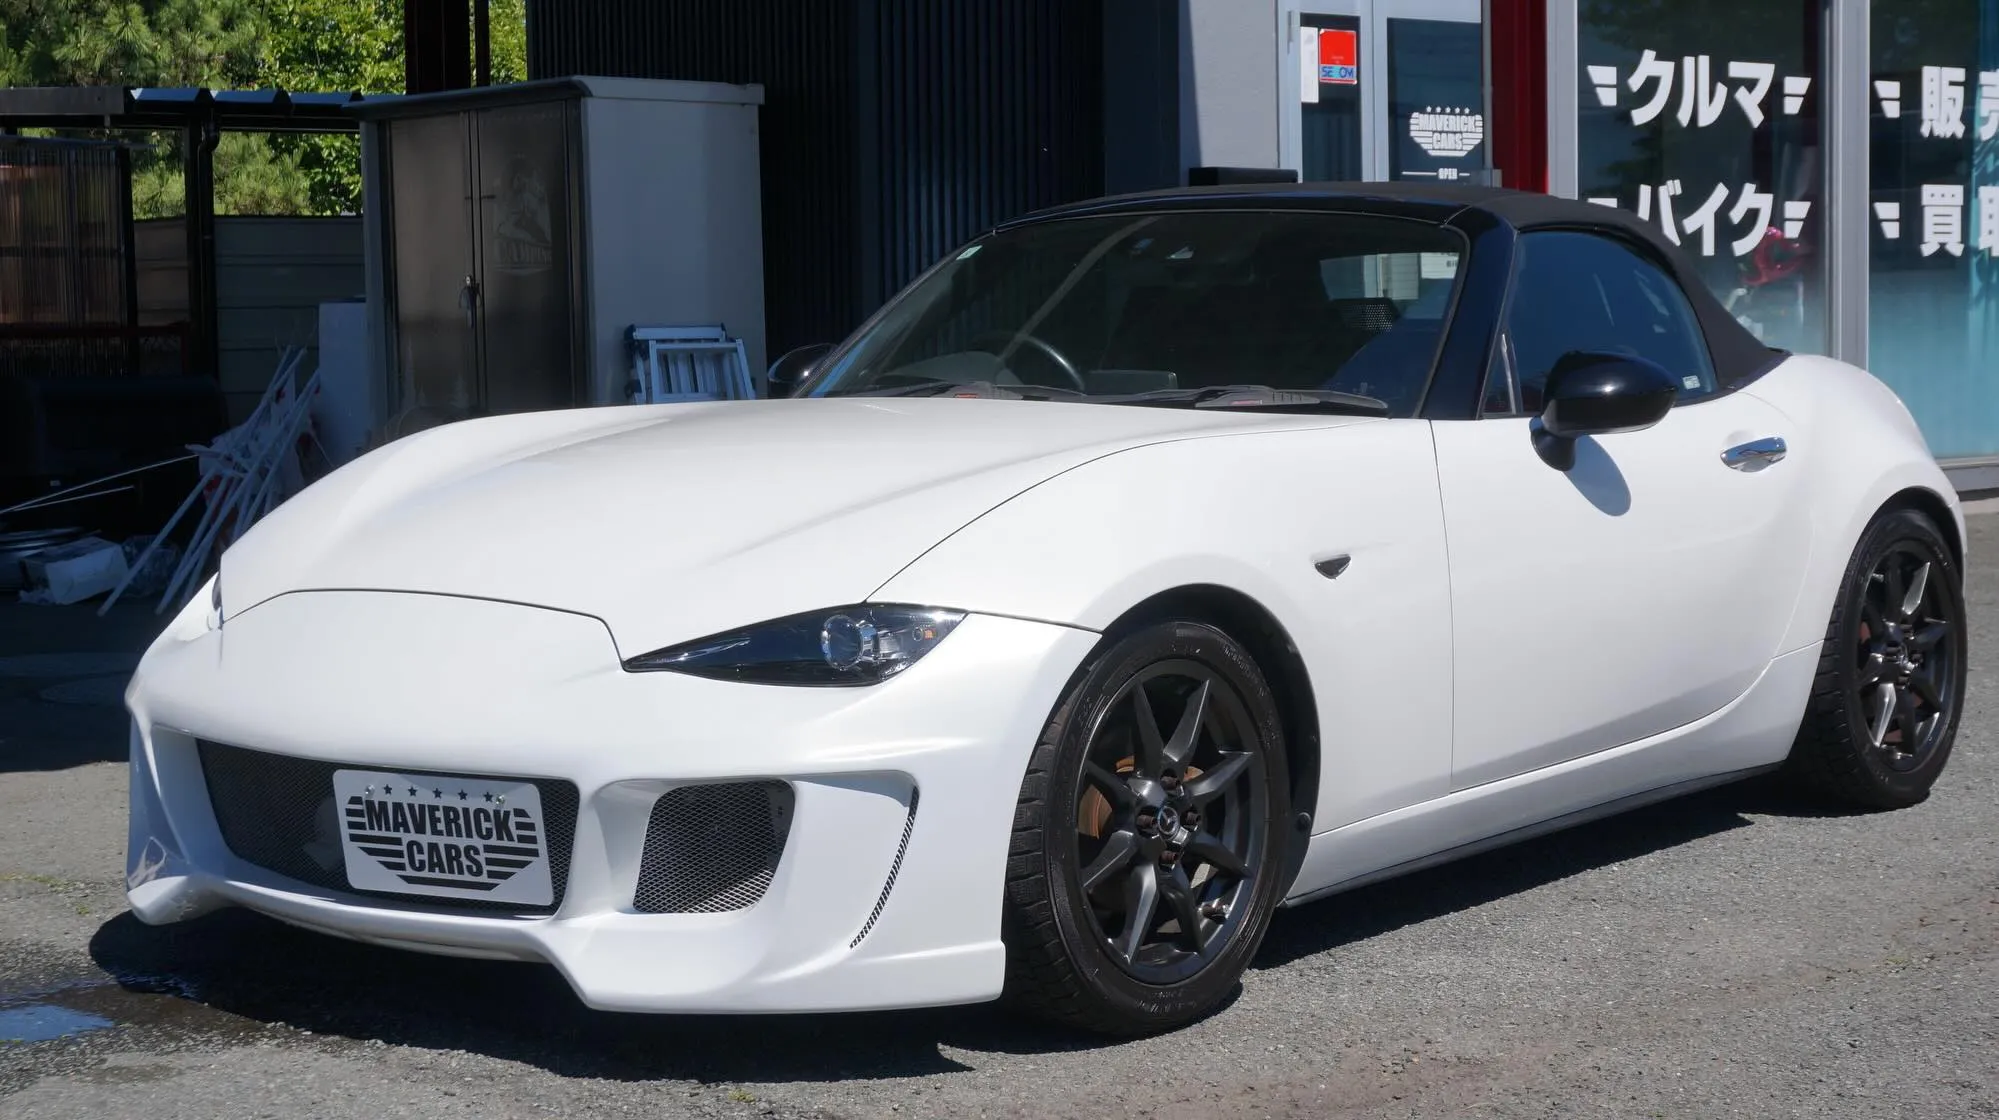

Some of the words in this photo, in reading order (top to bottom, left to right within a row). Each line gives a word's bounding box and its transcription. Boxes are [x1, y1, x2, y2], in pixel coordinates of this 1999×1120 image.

[1321, 66, 1354, 79] SEOM
[1627, 49, 1775, 128] クルマ
[1418, 113, 1476, 132] MAVERICK
[1432, 132, 1463, 150] CARS
[1438, 168, 1458, 180] OPEN
[1637, 179, 1774, 257] バイク
[364, 799, 515, 842] MAVERICK
[406, 840, 484, 877] CARS
